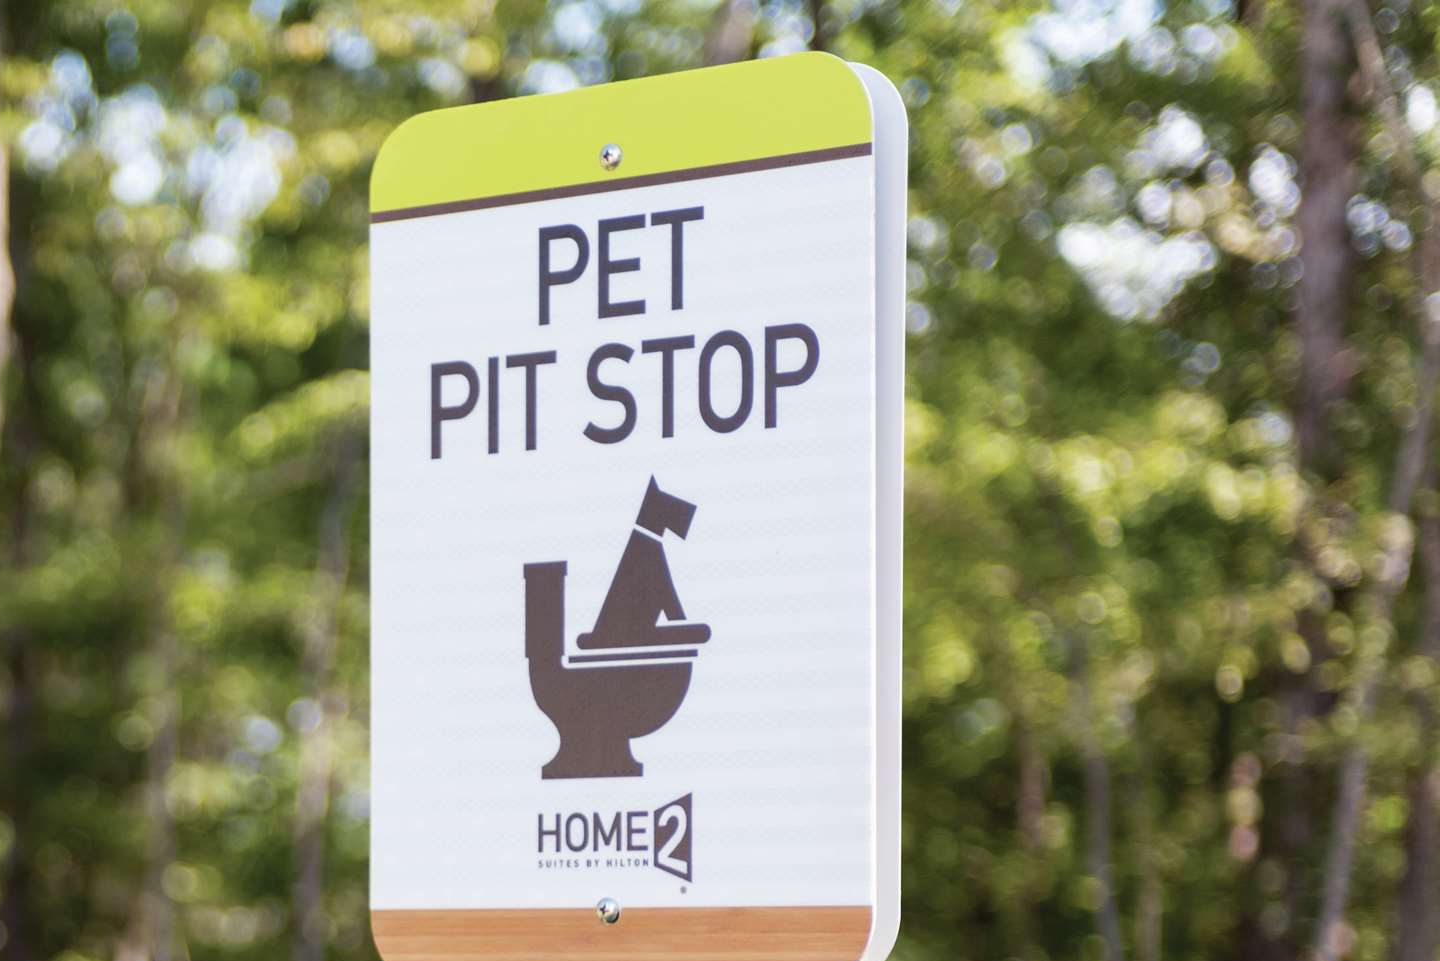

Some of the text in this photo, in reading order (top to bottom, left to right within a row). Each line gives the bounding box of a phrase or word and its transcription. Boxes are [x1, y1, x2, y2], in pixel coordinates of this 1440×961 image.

[538, 205, 705, 326] PET
[430, 322, 821, 460] PIT STOP
[538, 857, 649, 869] SUITES BY HILTON
